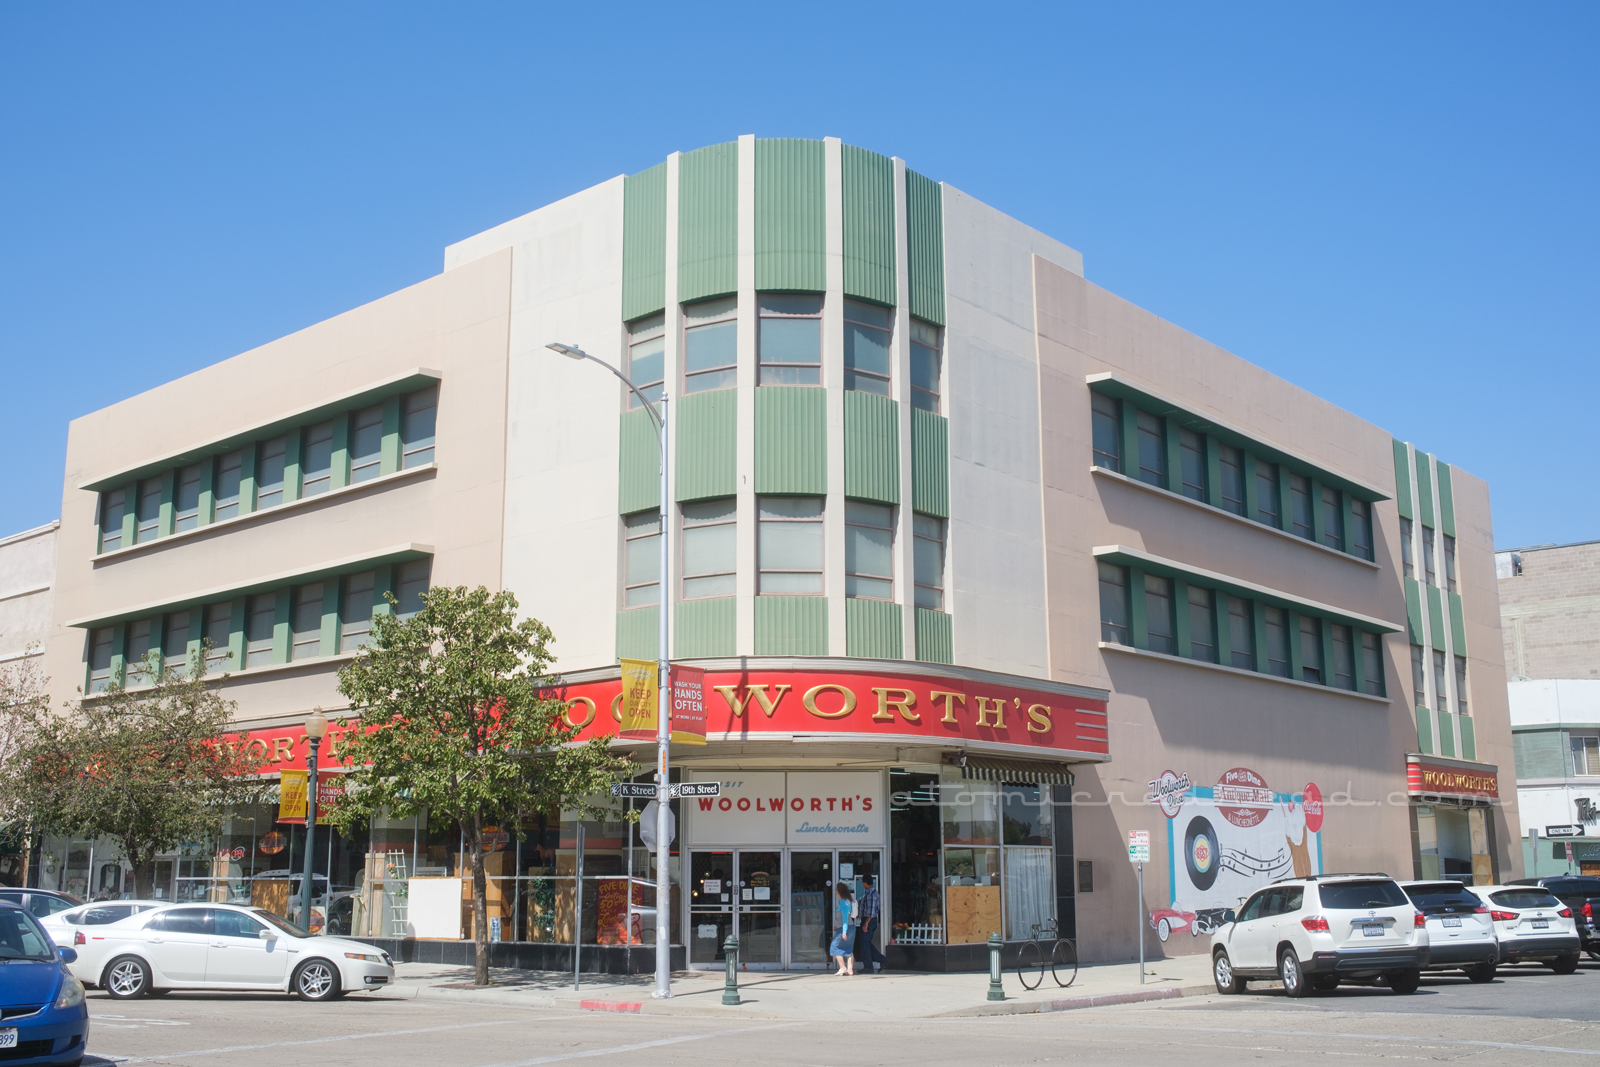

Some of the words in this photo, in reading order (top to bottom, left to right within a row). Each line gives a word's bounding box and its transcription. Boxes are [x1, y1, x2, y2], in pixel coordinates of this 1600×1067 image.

[674, 680, 688, 688] WASH
[688, 682, 702, 690] YOUR
[629, 687, 652, 700] KEEP
[674, 688, 703, 701] HANDS
[561, 683, 1052, 734] OWORTH'S
[674, 699, 703, 712] OFTEN
[628, 707, 652, 719] OPEN
[1226, 771, 1238, 784] Five
[1247, 771, 1261, 786] Dime
[1422, 769, 1497, 791] WOOLWORTH'S
[320, 788, 343, 796] HANDS
[622, 786, 629, 794] K
[631, 786, 656, 796] Street
[682, 785, 696, 795] 19th
[697, 784, 718, 795] Street
[1149, 773, 1190, 798] Woolworth
[285, 791, 302, 799] KEEP
[1219, 787, 1251, 804] Antique
[1252, 789, 1269, 803] Mall
[284, 804, 302, 812] OPEN
[698, 795, 873, 812] WOOLWORTH'S
[795, 821, 869, 833] Luncheonette
[231, 850, 245, 858] OPEN
[599, 881, 617, 894] FIVE
